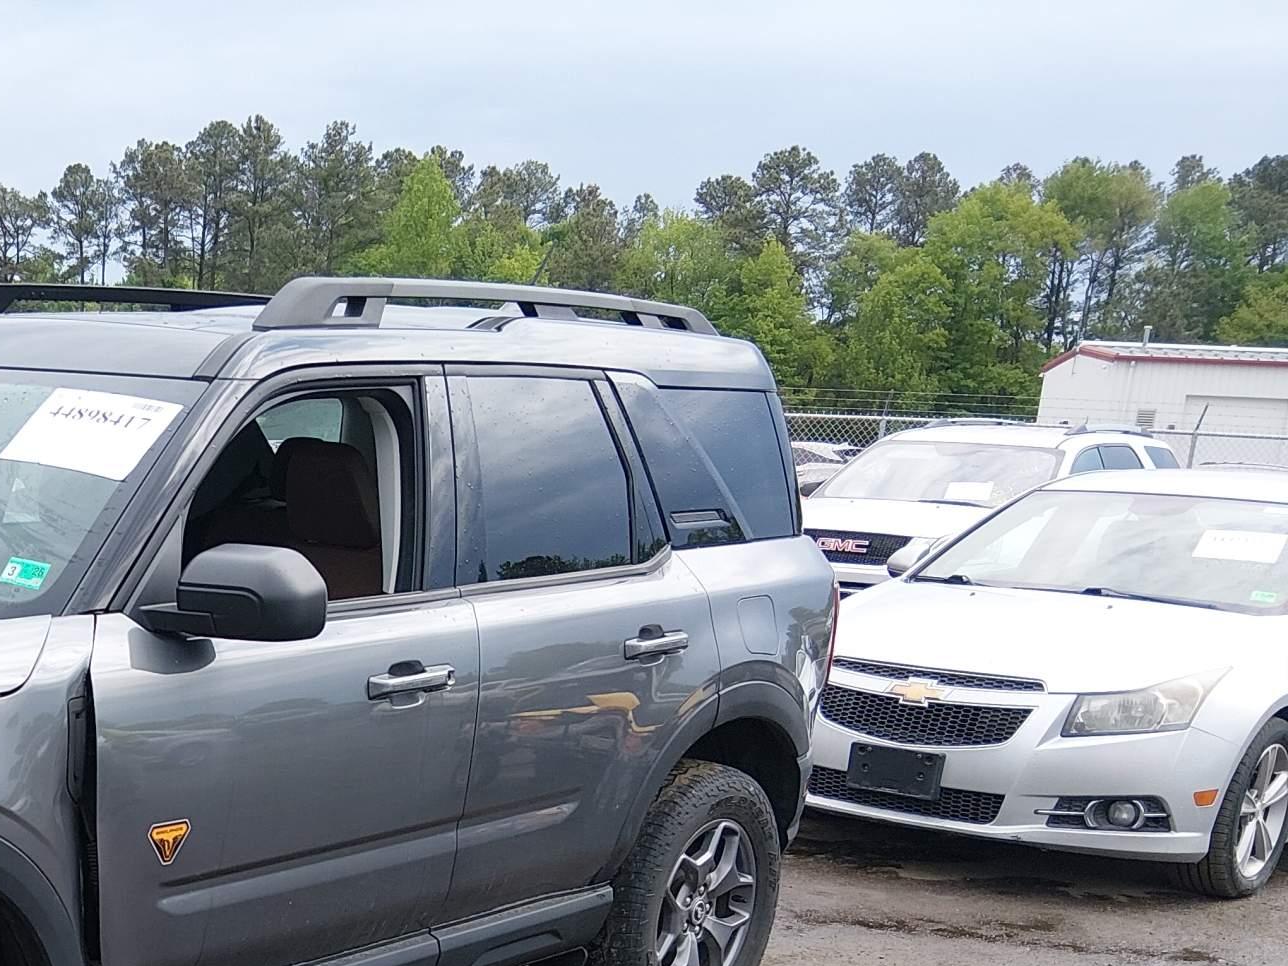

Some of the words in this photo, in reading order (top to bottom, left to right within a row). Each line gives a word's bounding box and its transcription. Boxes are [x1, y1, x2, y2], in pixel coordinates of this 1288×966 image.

[50, 405, 151, 430] 44898417
[816, 537, 869, 553] GMC
[7, 566, 17, 577] 3
